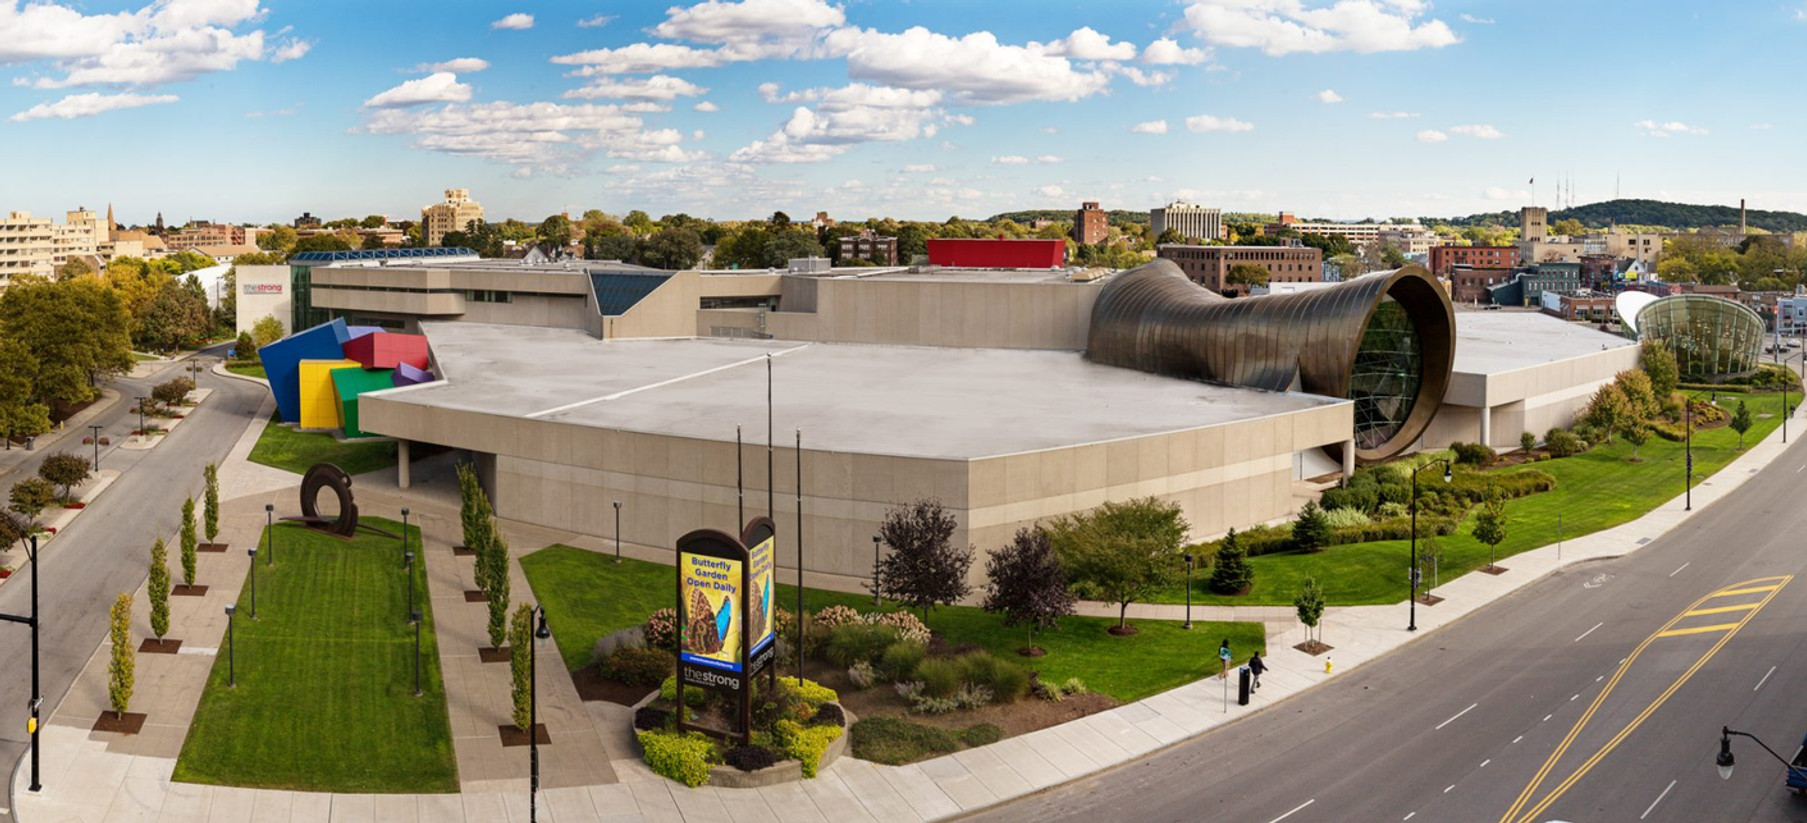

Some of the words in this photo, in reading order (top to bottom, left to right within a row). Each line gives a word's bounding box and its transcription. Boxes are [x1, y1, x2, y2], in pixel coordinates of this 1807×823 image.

[691, 556, 731, 572] Butterfly
[695, 568, 728, 580] Garden
[686, 577, 711, 588] Open
[713, 581, 736, 594] Daily
